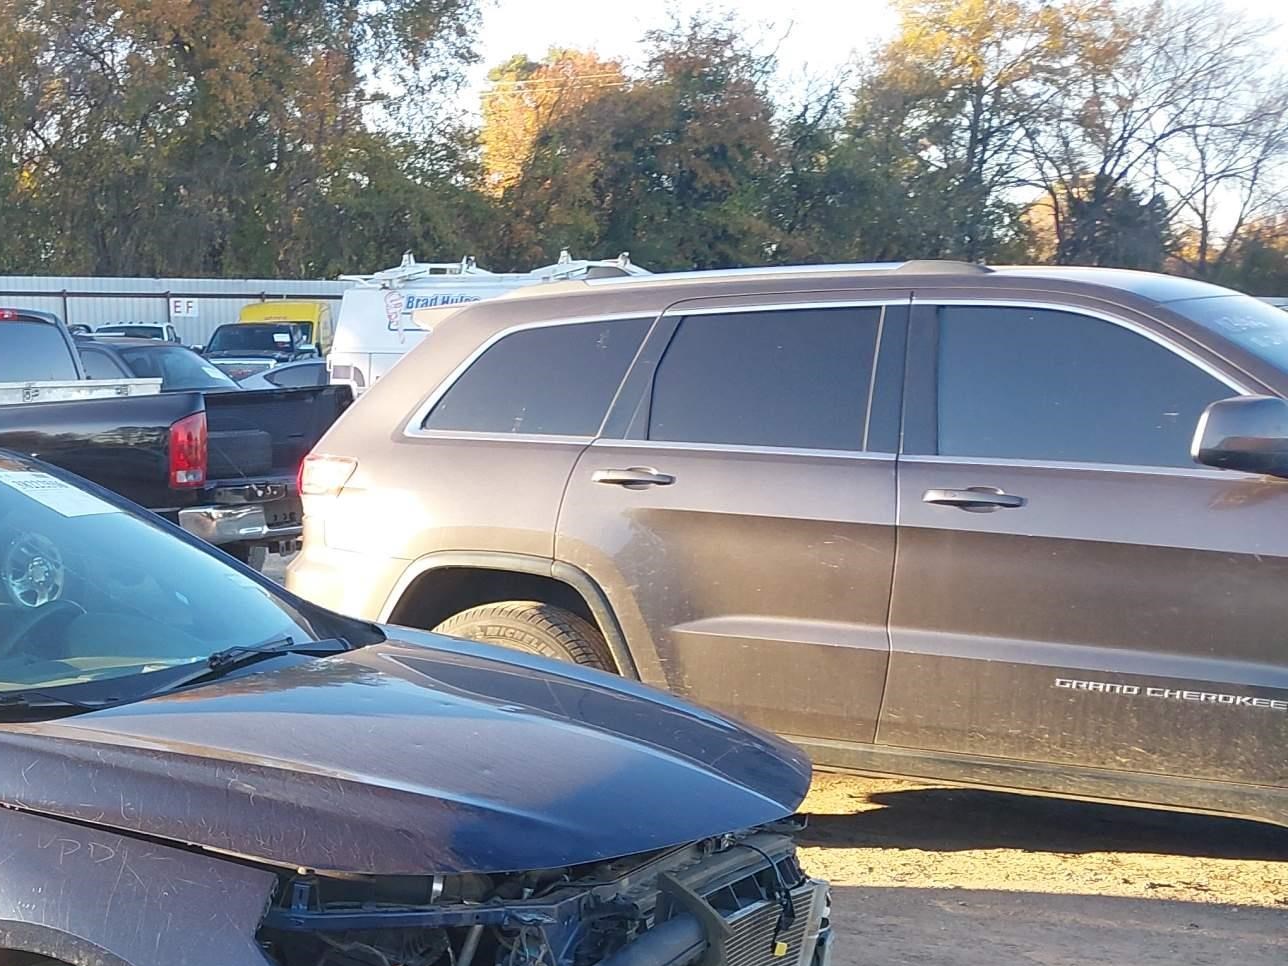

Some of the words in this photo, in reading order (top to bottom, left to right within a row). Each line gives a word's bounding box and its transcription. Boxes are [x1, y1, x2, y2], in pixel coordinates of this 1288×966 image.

[174, 301, 181, 313] E
[186, 301, 194, 314] F
[405, 294, 439, 309] Brad
[1055, 678, 1139, 695] GRAND
[1146, 687, 1288, 710] CHEROKEE
